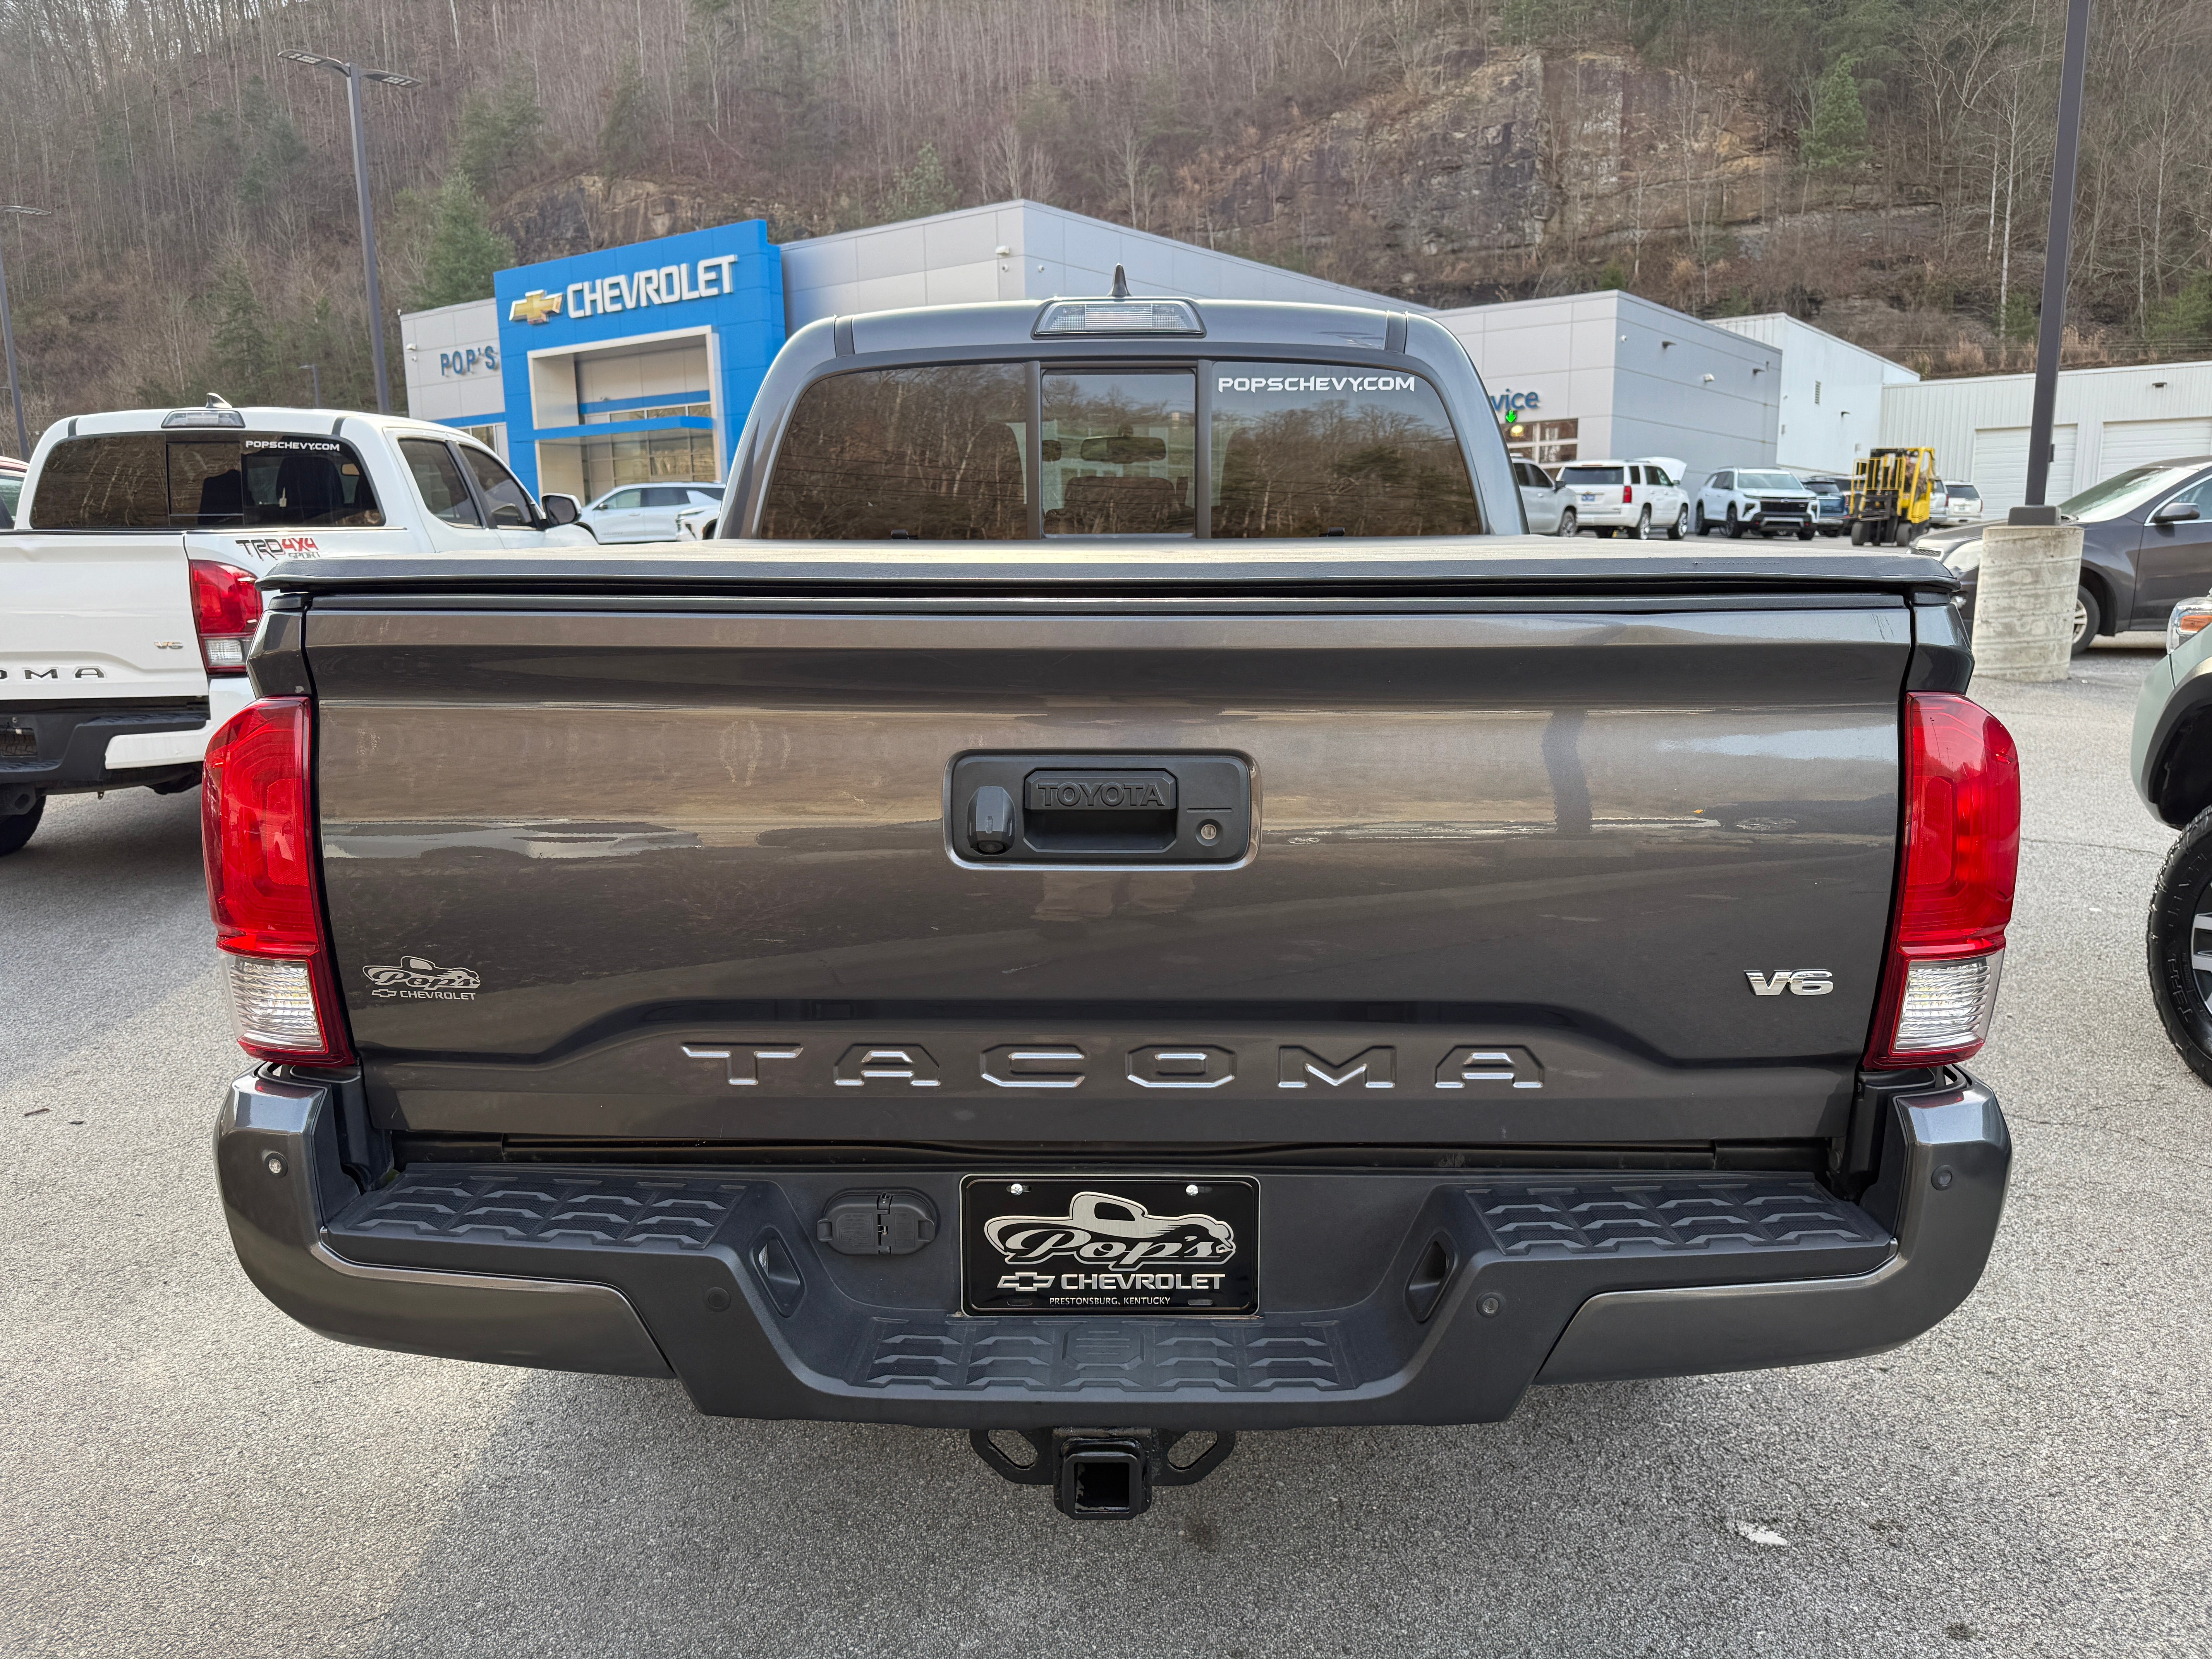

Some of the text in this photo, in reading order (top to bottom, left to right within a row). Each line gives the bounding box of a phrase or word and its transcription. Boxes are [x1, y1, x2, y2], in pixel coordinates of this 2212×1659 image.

[567, 254, 738, 318] CHEVROLET
[440, 346, 496, 376] POP'S
[1218, 376, 1415, 393] POPSCHEVY.COM
[1491, 388, 1539, 410] vice
[246, 440, 340, 451] POPSCHEVY.COM
[1037, 783, 1165, 807] TOYOTA
[1743, 969, 1834, 996] V6
[400, 990, 476, 1000] CHEVROLET
[680, 1042, 1545, 1089] TACOMA
[1005, 1228, 1223, 1266] Pop's
[1061, 1273, 1225, 1290] CHEVROLET
[1049, 1297, 1171, 1305] PRESTONSBURG, KENTUCKY
